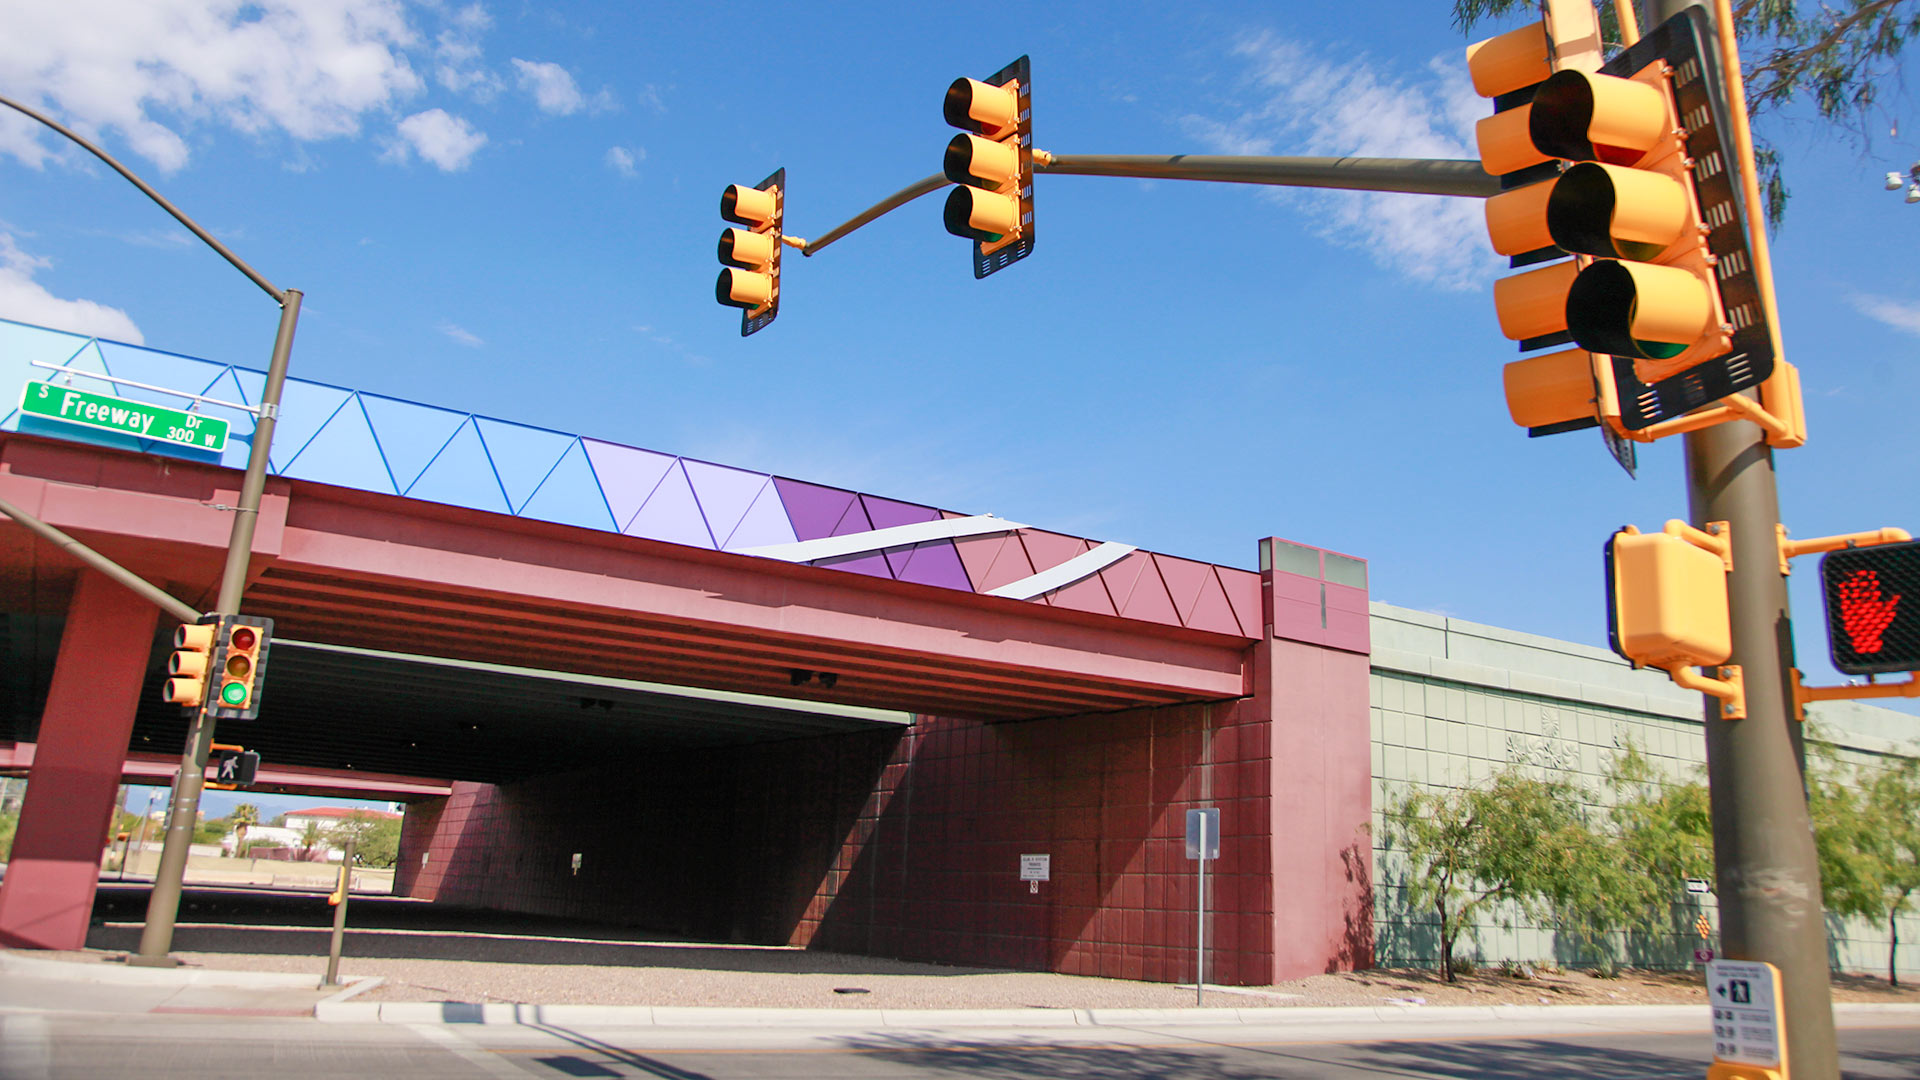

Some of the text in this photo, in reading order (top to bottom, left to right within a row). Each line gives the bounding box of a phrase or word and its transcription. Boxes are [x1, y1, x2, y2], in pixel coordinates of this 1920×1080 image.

[38, 385, 203, 435] S Freeway Dr
[166, 426, 216, 447] 300 W
